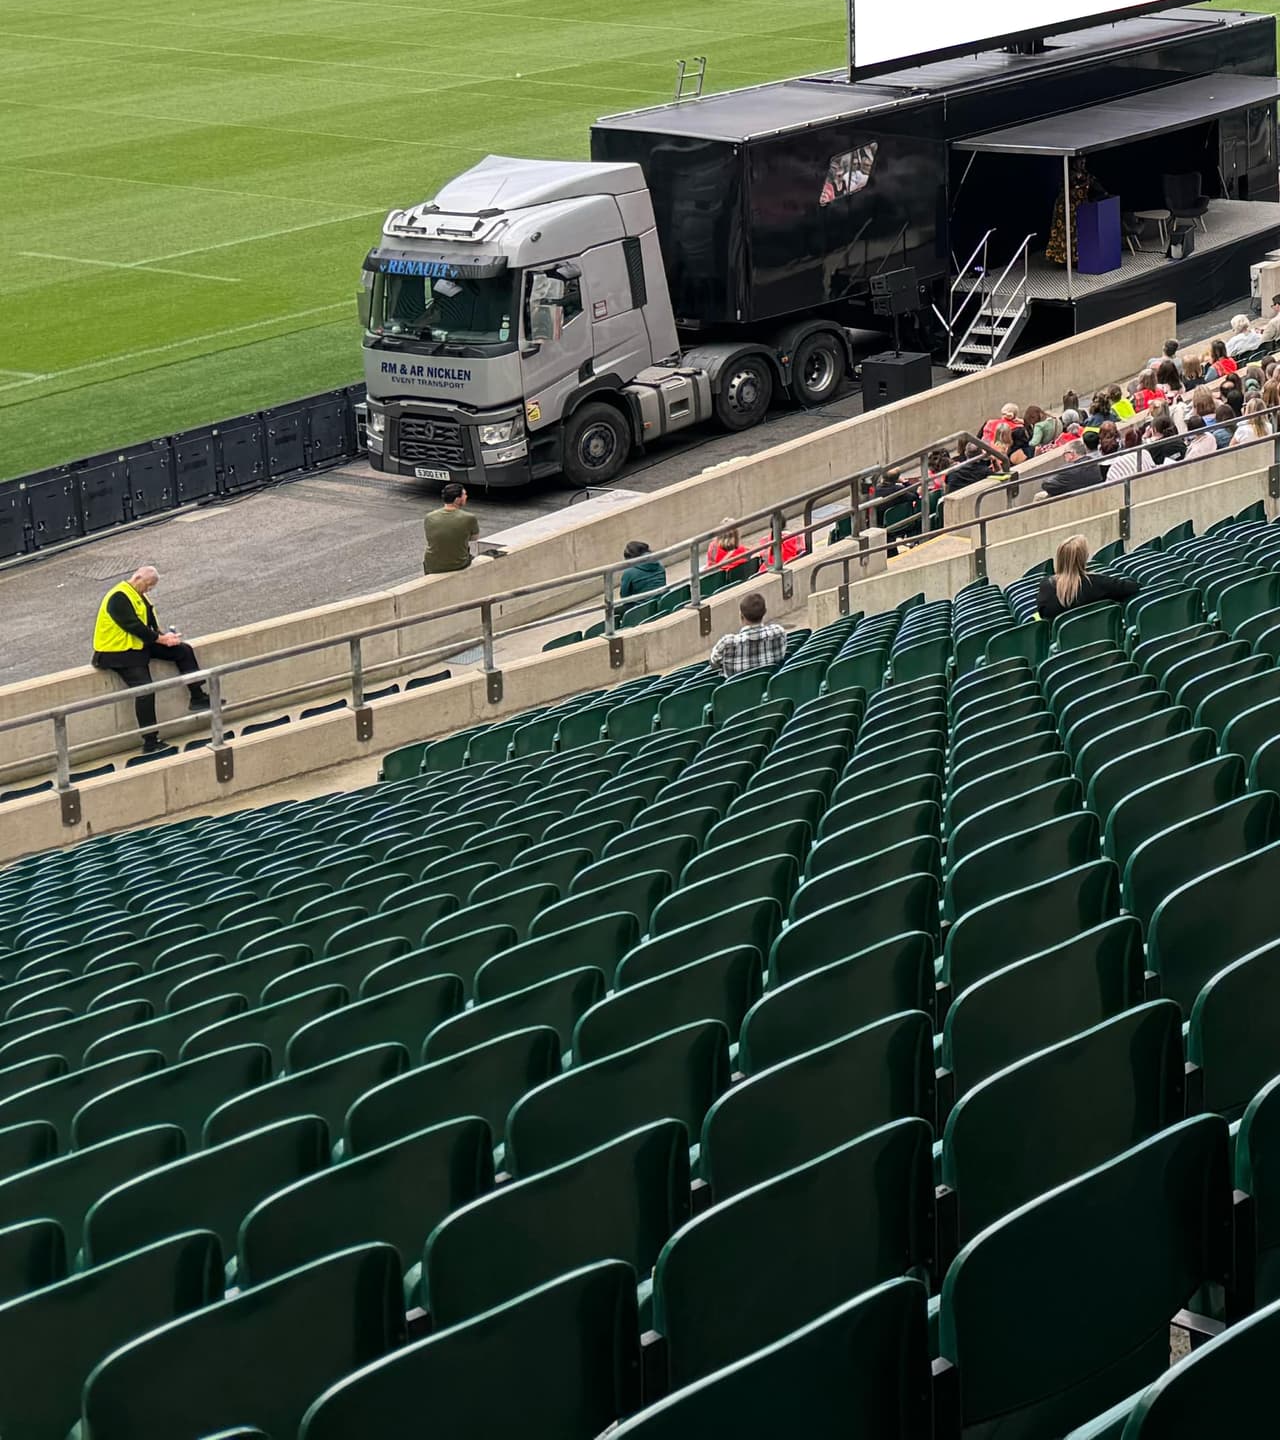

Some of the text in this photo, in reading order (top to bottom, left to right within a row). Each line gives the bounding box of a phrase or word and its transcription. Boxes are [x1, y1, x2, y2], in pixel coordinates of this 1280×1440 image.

[388, 258, 449, 278] RENAULT
[381, 361, 471, 381] RM & AR NICKLEN
[391, 376, 465, 389] EVENT TRANSPORT
